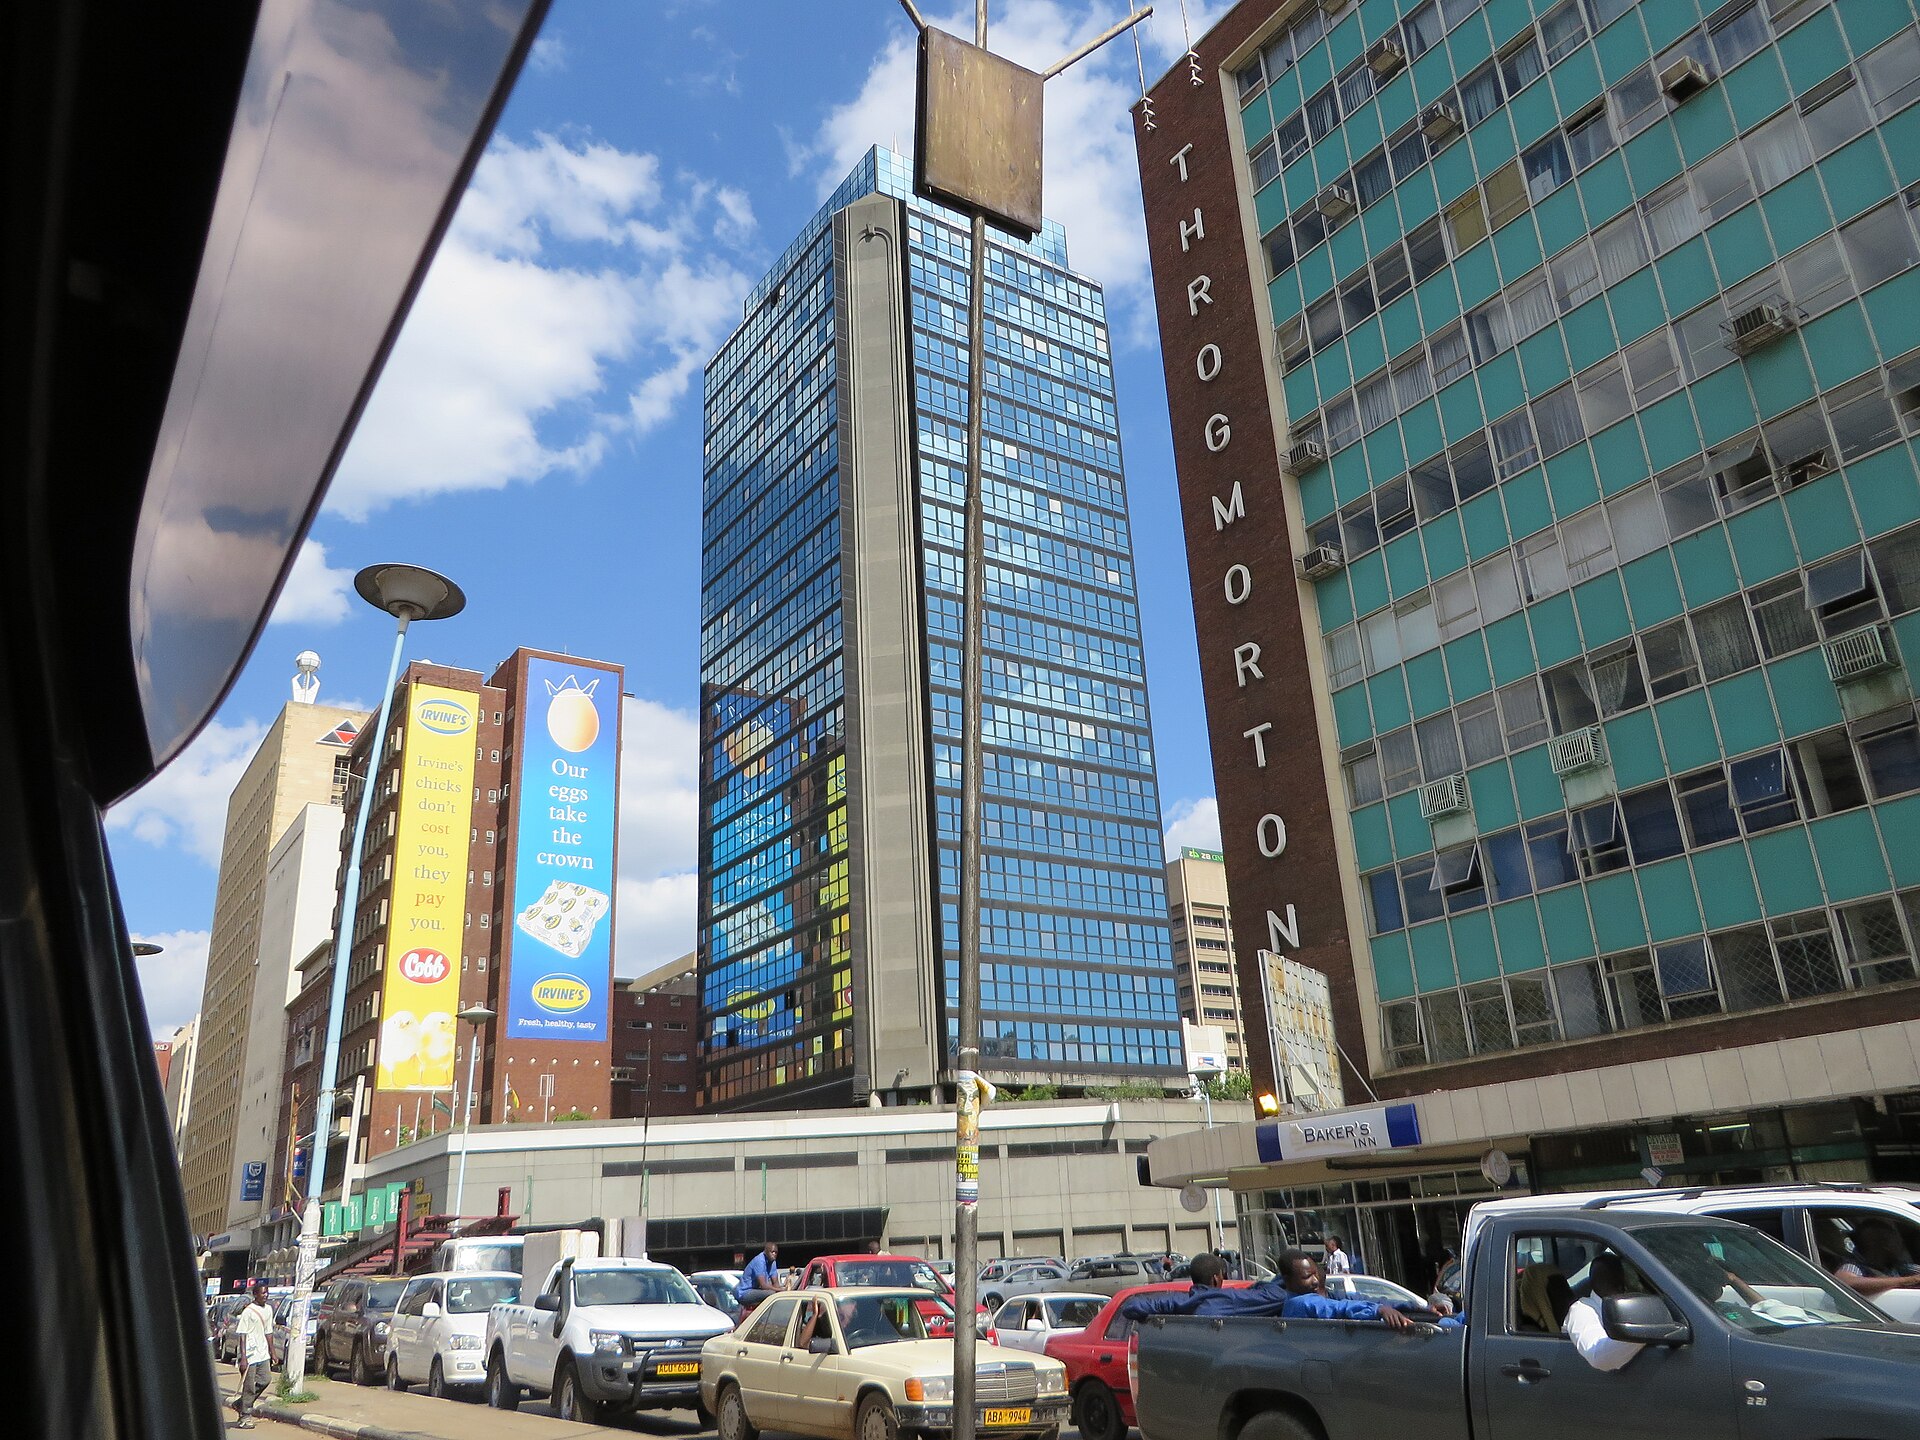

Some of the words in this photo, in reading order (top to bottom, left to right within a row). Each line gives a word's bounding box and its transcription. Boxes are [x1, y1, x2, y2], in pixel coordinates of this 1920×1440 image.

[1169, 142, 1300, 954] THROGMORTON
[421, 709, 468, 725] IRVINE'S
[417, 755, 463, 772] Irvine's
[551, 758, 589, 779] Our
[415, 776, 462, 793] chicks
[548, 785, 588, 804] eggs
[418, 797, 456, 814] don't
[549, 804, 588, 823] take
[421, 822, 451, 835] cost
[552, 826, 582, 845] the
[417, 844, 449, 859] you,
[536, 851, 594, 870] crown
[414, 864, 450, 885] they
[414, 892, 446, 909] pay
[409, 917, 445, 932] you.
[404, 952, 445, 979] Cobb
[537, 987, 585, 1001] IRVINE'S
[518, 1018, 544, 1027] Fresh,
[544, 1019, 575, 1029] healthy,
[576, 1021, 597, 1030] tasty
[1304, 1121, 1371, 1143] BAKER'S
[1353, 1136, 1378, 1148] INN
[987, 1411, 1003, 1423] ABA
